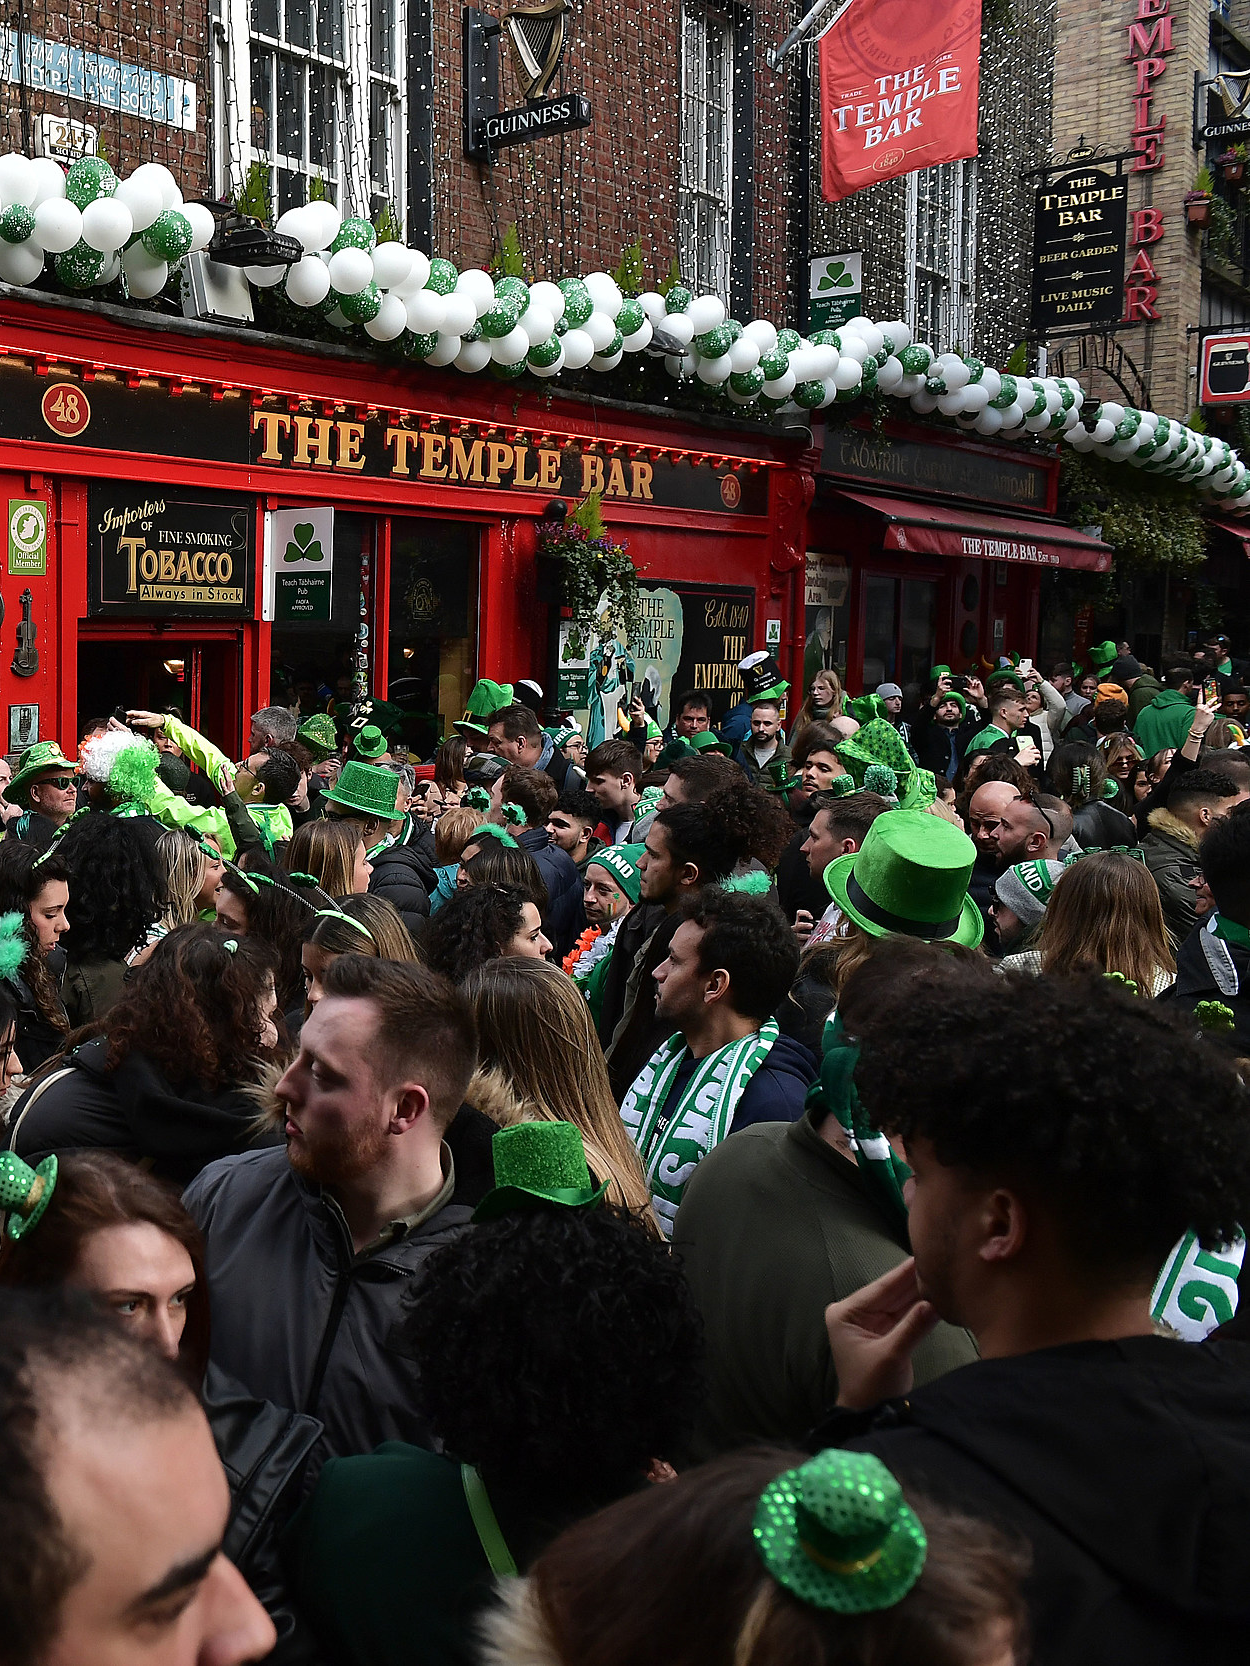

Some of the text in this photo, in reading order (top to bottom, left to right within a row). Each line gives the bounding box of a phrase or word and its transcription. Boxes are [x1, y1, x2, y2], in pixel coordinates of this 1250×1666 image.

[874, 64, 926, 96] THE
[121, 91, 164, 116] SOUTH
[831, 67, 962, 132] TEMPLE
[840, 90, 863, 100] TRADE
[486, 102, 570, 137] GUINNESS
[863, 107, 923, 149] BAR
[1067, 176, 1097, 189] THE
[1039, 186, 1124, 211] TEMPLE
[1058, 209, 1104, 227] BAR
[1039, 244, 1119, 263] BEER GARDEN
[1121, 207, 1165, 323] BAR
[1040, 285, 1114, 303] LIVE MUSIC
[1056, 301, 1096, 314] DAILY
[1211, 359, 1245, 367] GUINNESS
[50, 391, 81, 425] 48
[252, 410, 655, 500] THE TEMPLE BAR
[722, 482, 738, 500] 48
[98, 499, 166, 536] Importers
[141, 521, 153, 531] OF
[158, 530, 232, 547] FINE SMOKING
[17, 552, 39, 560] Official
[961, 536, 982, 555] THE
[982, 539, 1019, 560] TEMPLE
[1019, 544, 1038, 562] BAR
[15, 559, 41, 568] Member
[116, 536, 233, 594] TOBACCO
[282, 578, 325, 587] Teach Tábhairne
[297, 587, 309, 596] Pub
[141, 585, 242, 601] Always in Stock
[639, 598, 664, 617] THE
[730, 605, 749, 628] 1840
[635, 620, 675, 639] EMPLE
[637, 640, 663, 660] BAR
[723, 635, 746, 661] THE
